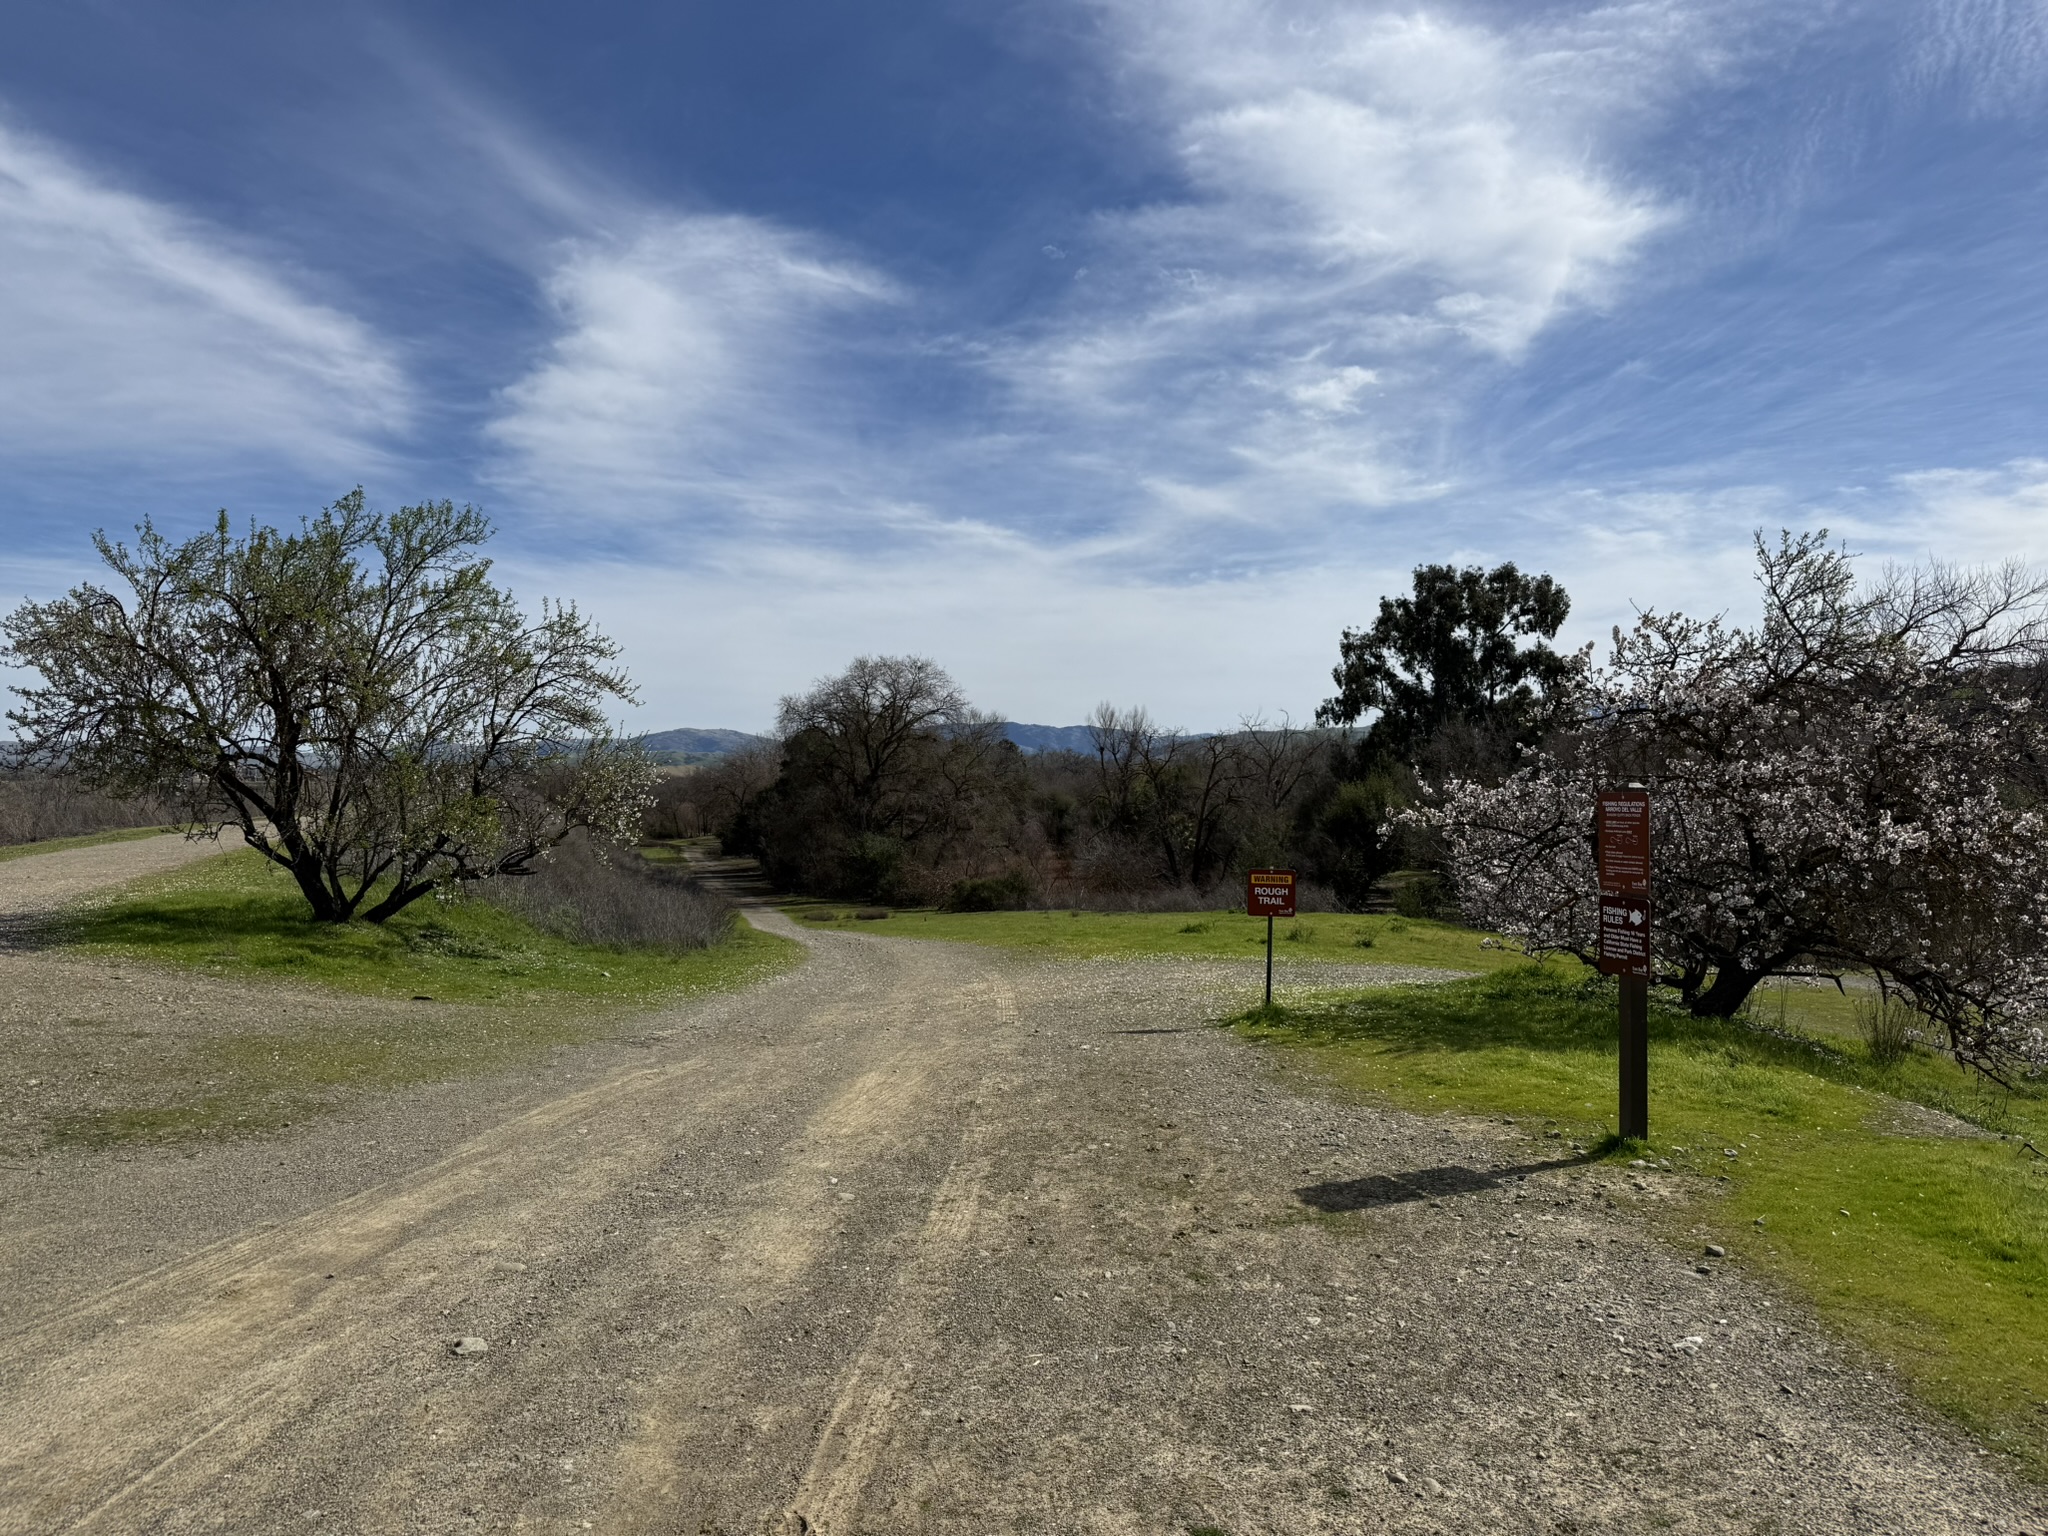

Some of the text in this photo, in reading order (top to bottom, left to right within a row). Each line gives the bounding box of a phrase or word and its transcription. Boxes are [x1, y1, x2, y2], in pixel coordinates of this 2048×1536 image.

[1254, 887, 1288, 895] ROUGH
[1258, 897, 1285, 905] TRAIL
[1603, 906, 1627, 916] FISHING
[1603, 915, 1623, 925] RULES
[1617, 928, 1630, 936] Fishing
[1630, 943, 1642, 951] Fishing
[1603, 951, 1616, 959] Fishing
